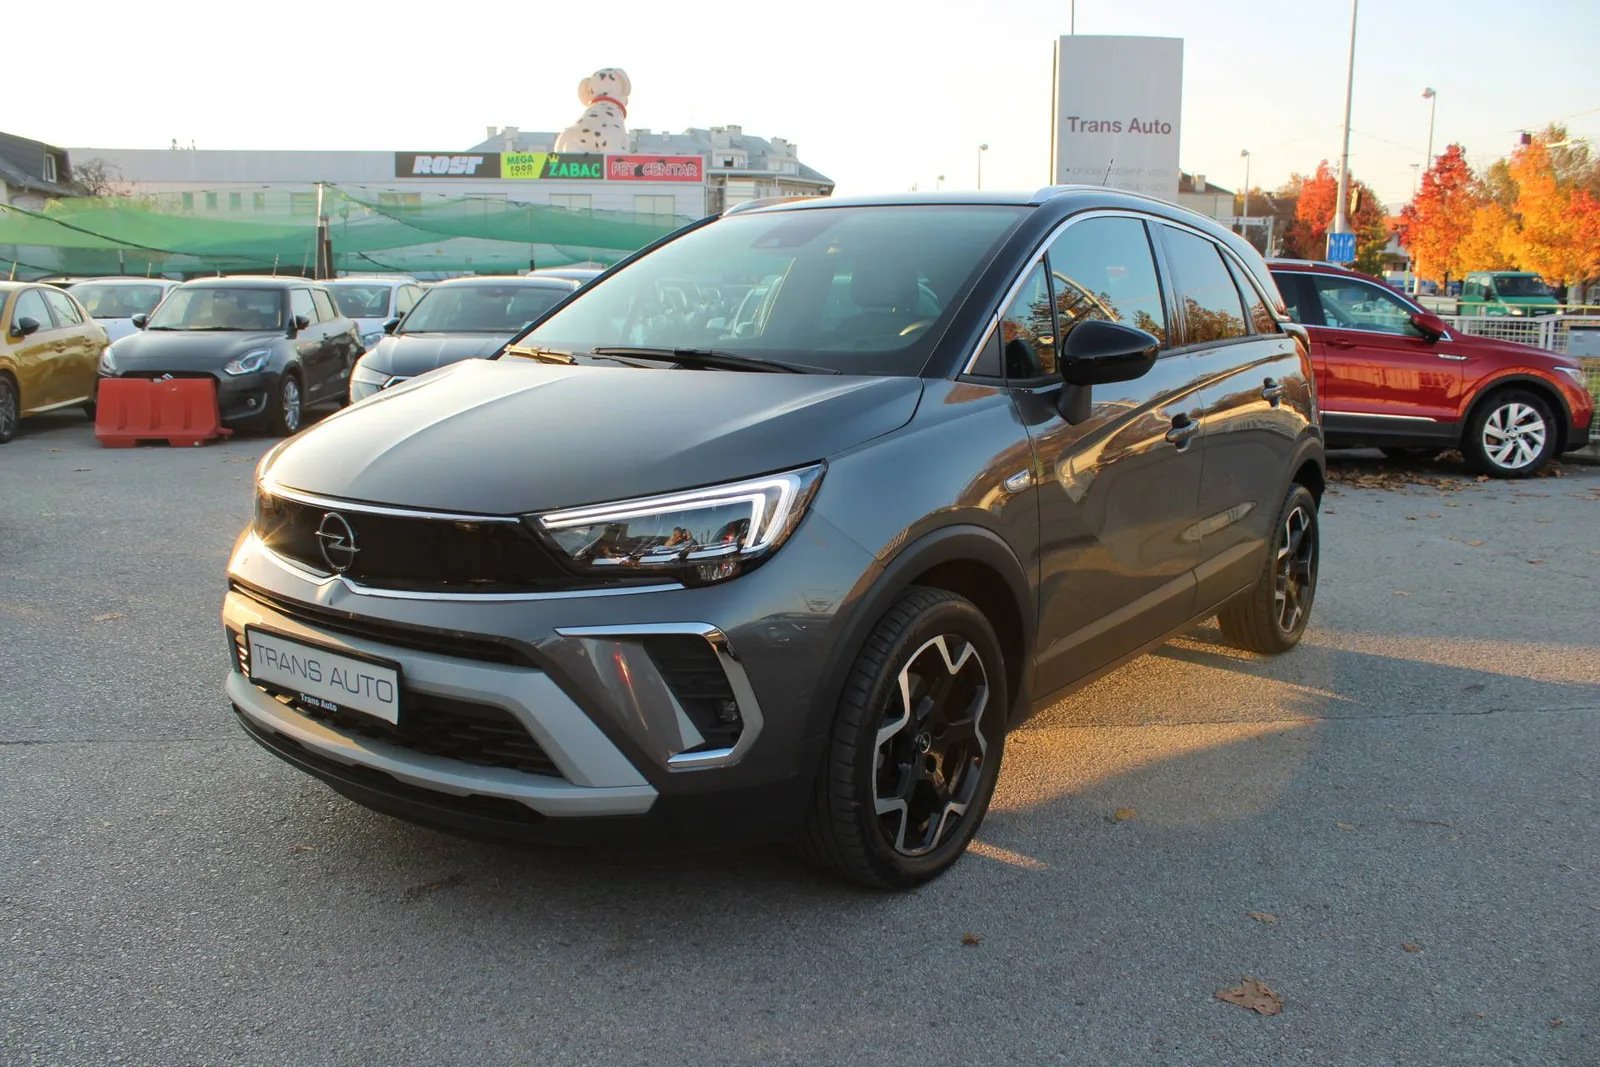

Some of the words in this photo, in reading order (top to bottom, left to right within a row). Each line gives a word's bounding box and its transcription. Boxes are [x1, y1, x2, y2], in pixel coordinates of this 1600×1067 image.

[1067, 116, 1122, 133] Trans
[1128, 117, 1172, 135] Auto
[507, 154, 534, 166] MEGA
[510, 164, 533, 173] FOOD
[611, 162, 635, 176] PET
[642, 162, 697, 177] CENTAR
[254, 643, 322, 683] TRANS
[330, 667, 393, 704] AUTO
[300, 693, 320, 707] Trans
[320, 700, 338, 712] Auto
